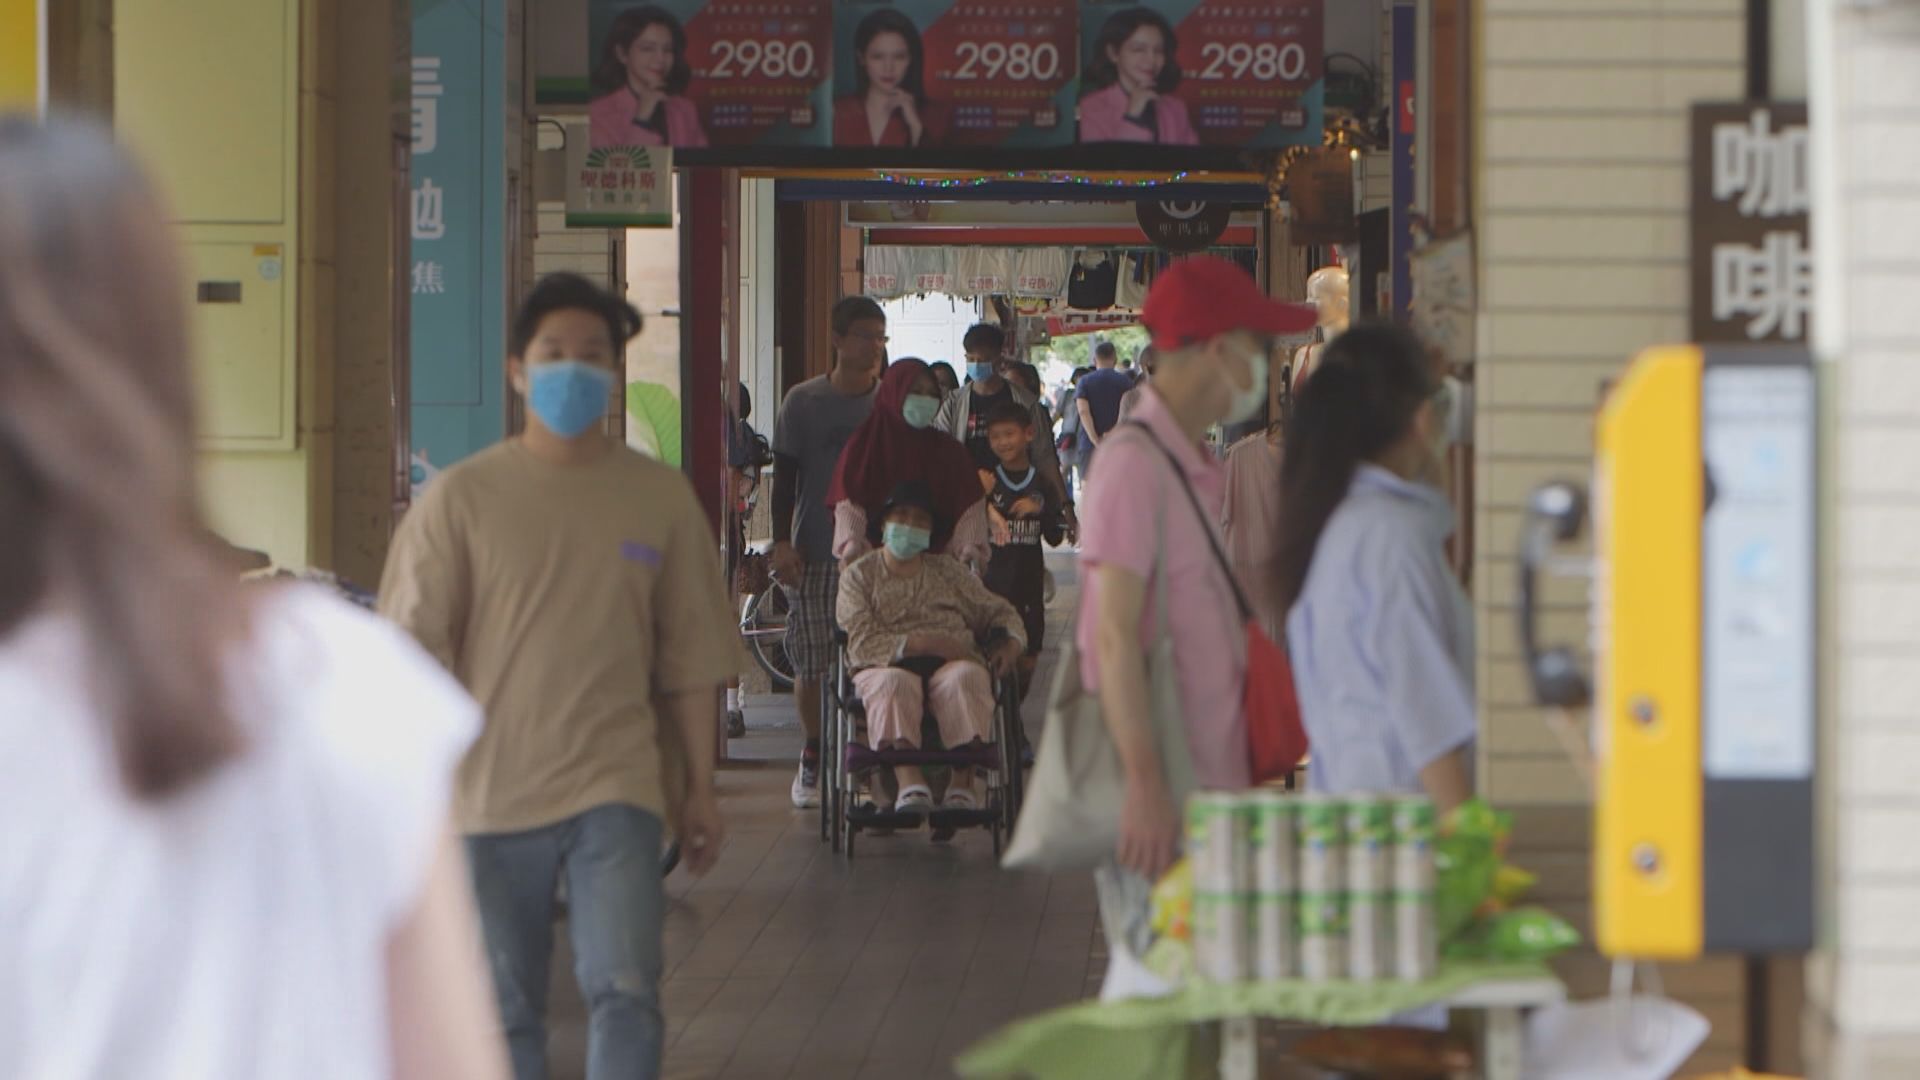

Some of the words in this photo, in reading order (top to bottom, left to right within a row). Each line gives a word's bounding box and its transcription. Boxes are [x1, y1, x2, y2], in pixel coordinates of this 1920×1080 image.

[708, 39, 814, 78] 2980
[953, 41, 1059, 80] 2980
[1200, 42, 1305, 80] 2980
[1711, 107, 1810, 340] 咖啡
